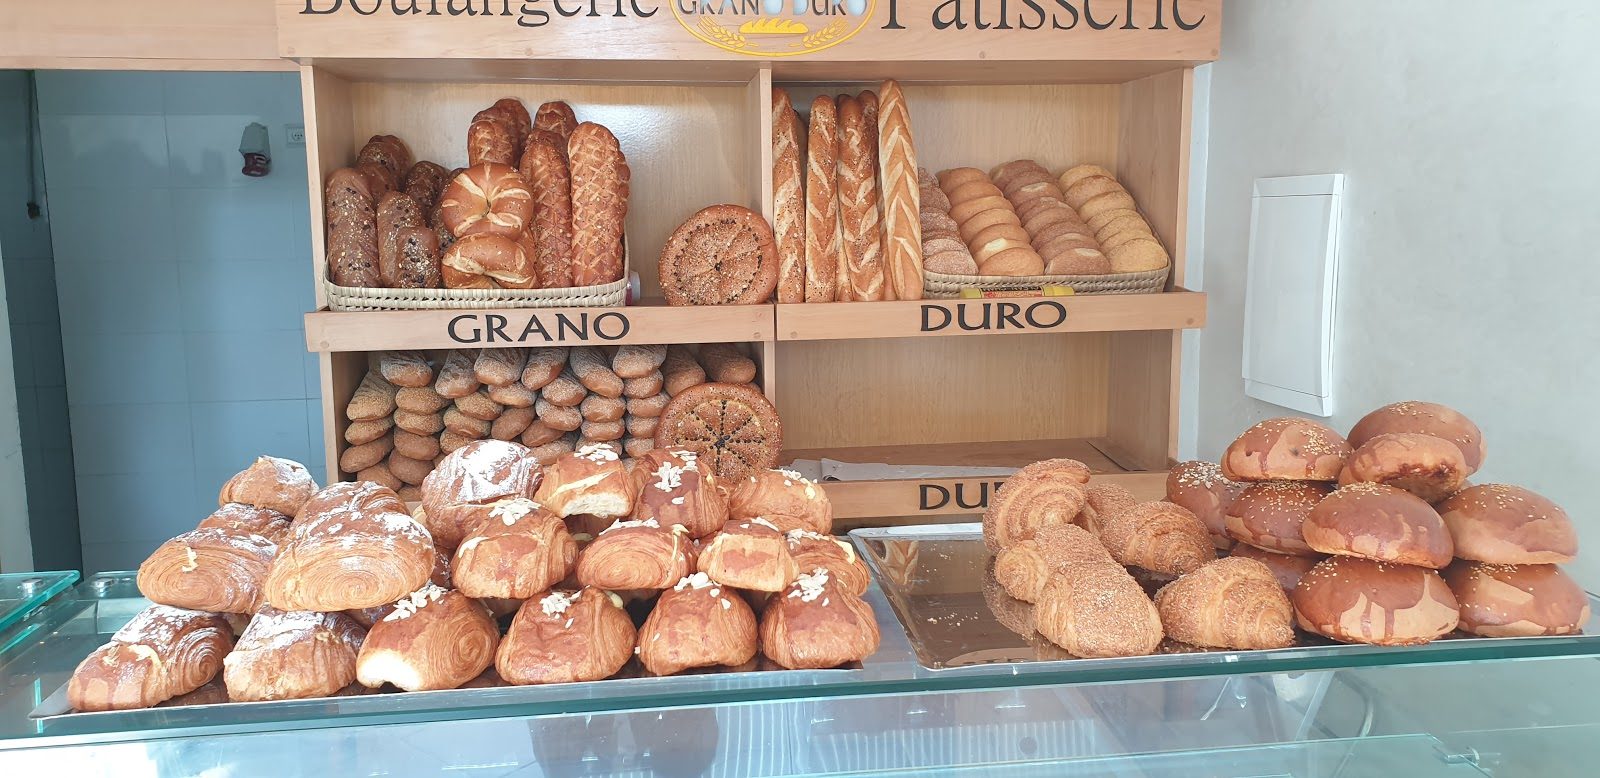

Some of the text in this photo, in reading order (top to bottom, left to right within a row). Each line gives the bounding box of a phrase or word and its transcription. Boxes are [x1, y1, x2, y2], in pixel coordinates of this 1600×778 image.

[447, 312, 631, 344] GRANO
[920, 300, 1067, 332] DURO
[918, 481, 1005, 511] DU
